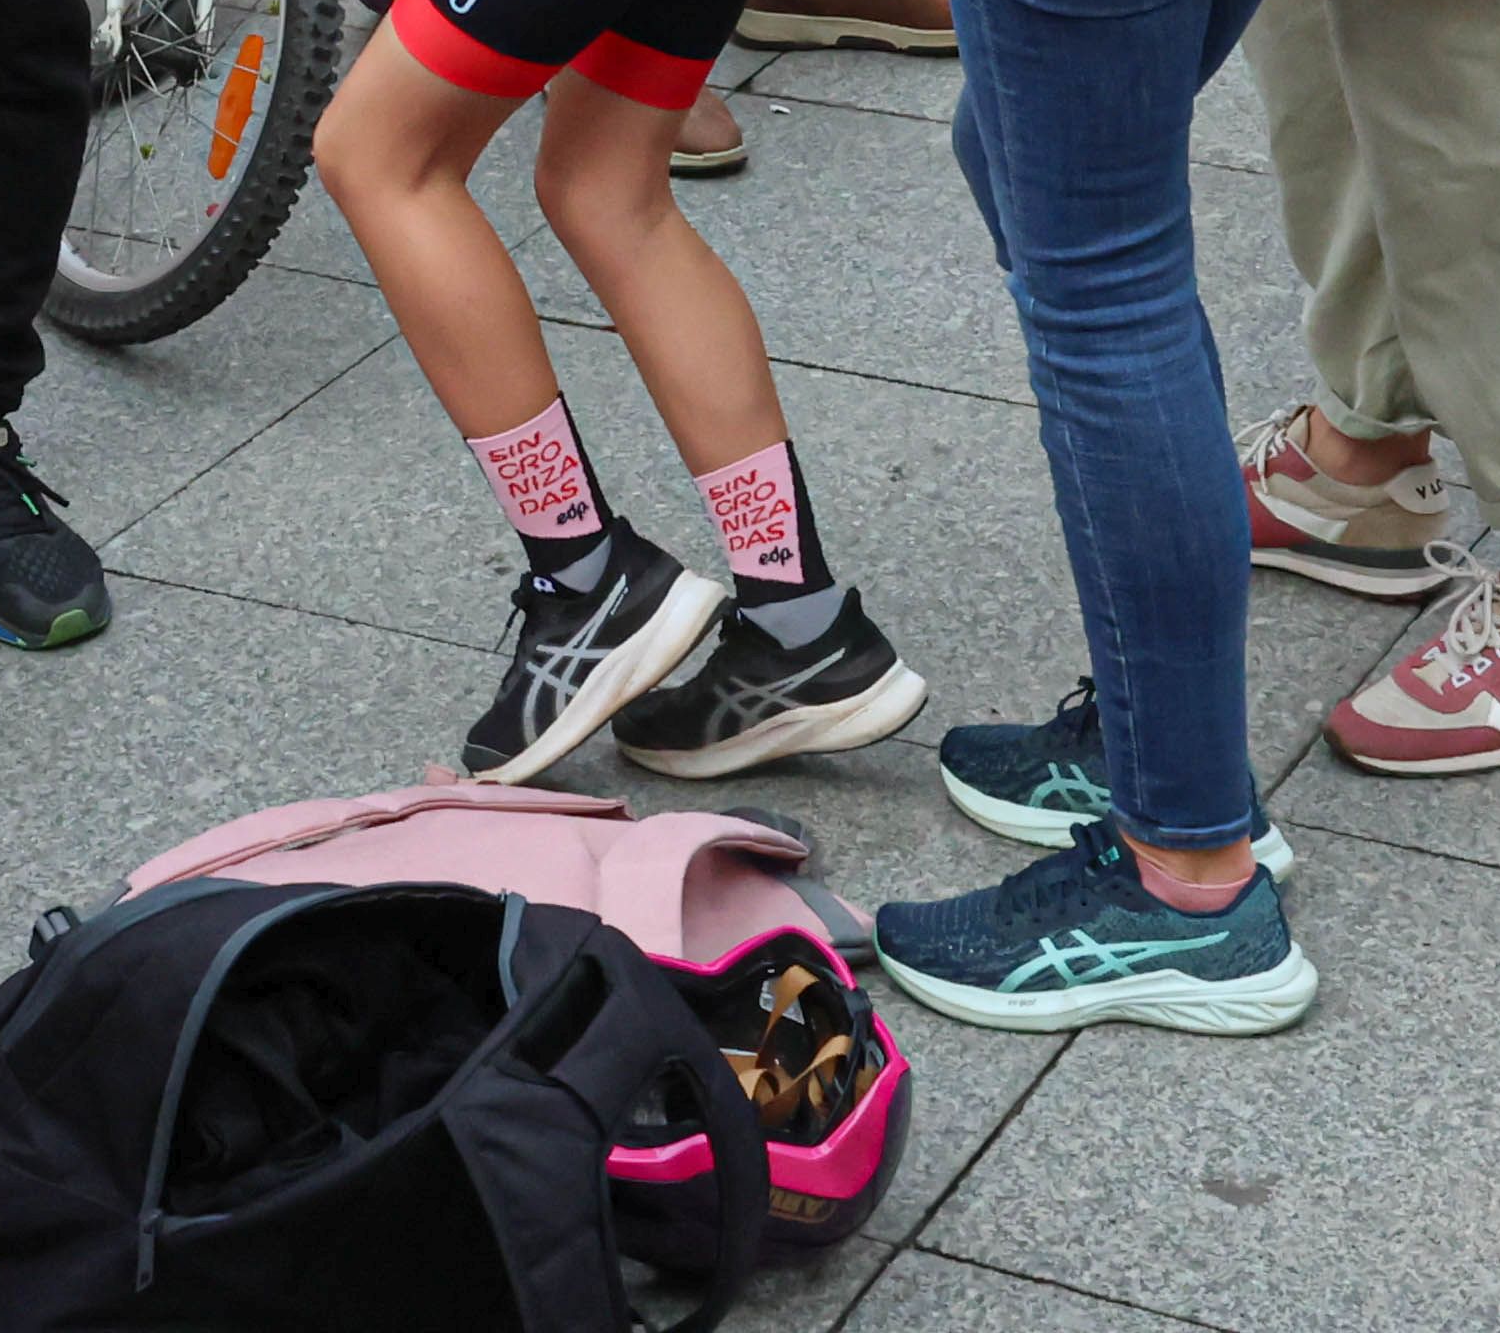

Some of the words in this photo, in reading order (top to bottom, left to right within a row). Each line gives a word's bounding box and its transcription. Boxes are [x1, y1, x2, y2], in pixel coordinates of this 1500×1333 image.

[488, 431, 541, 464] SIN
[497, 440, 562, 481] CRO
[508, 454, 579, 498] NIZA
[708, 468, 758, 501] SIN
[519, 478, 578, 516] DAS
[714, 481, 777, 518] CRO
[721, 498, 792, 535] NIZA
[729, 521, 785, 553] DAS
